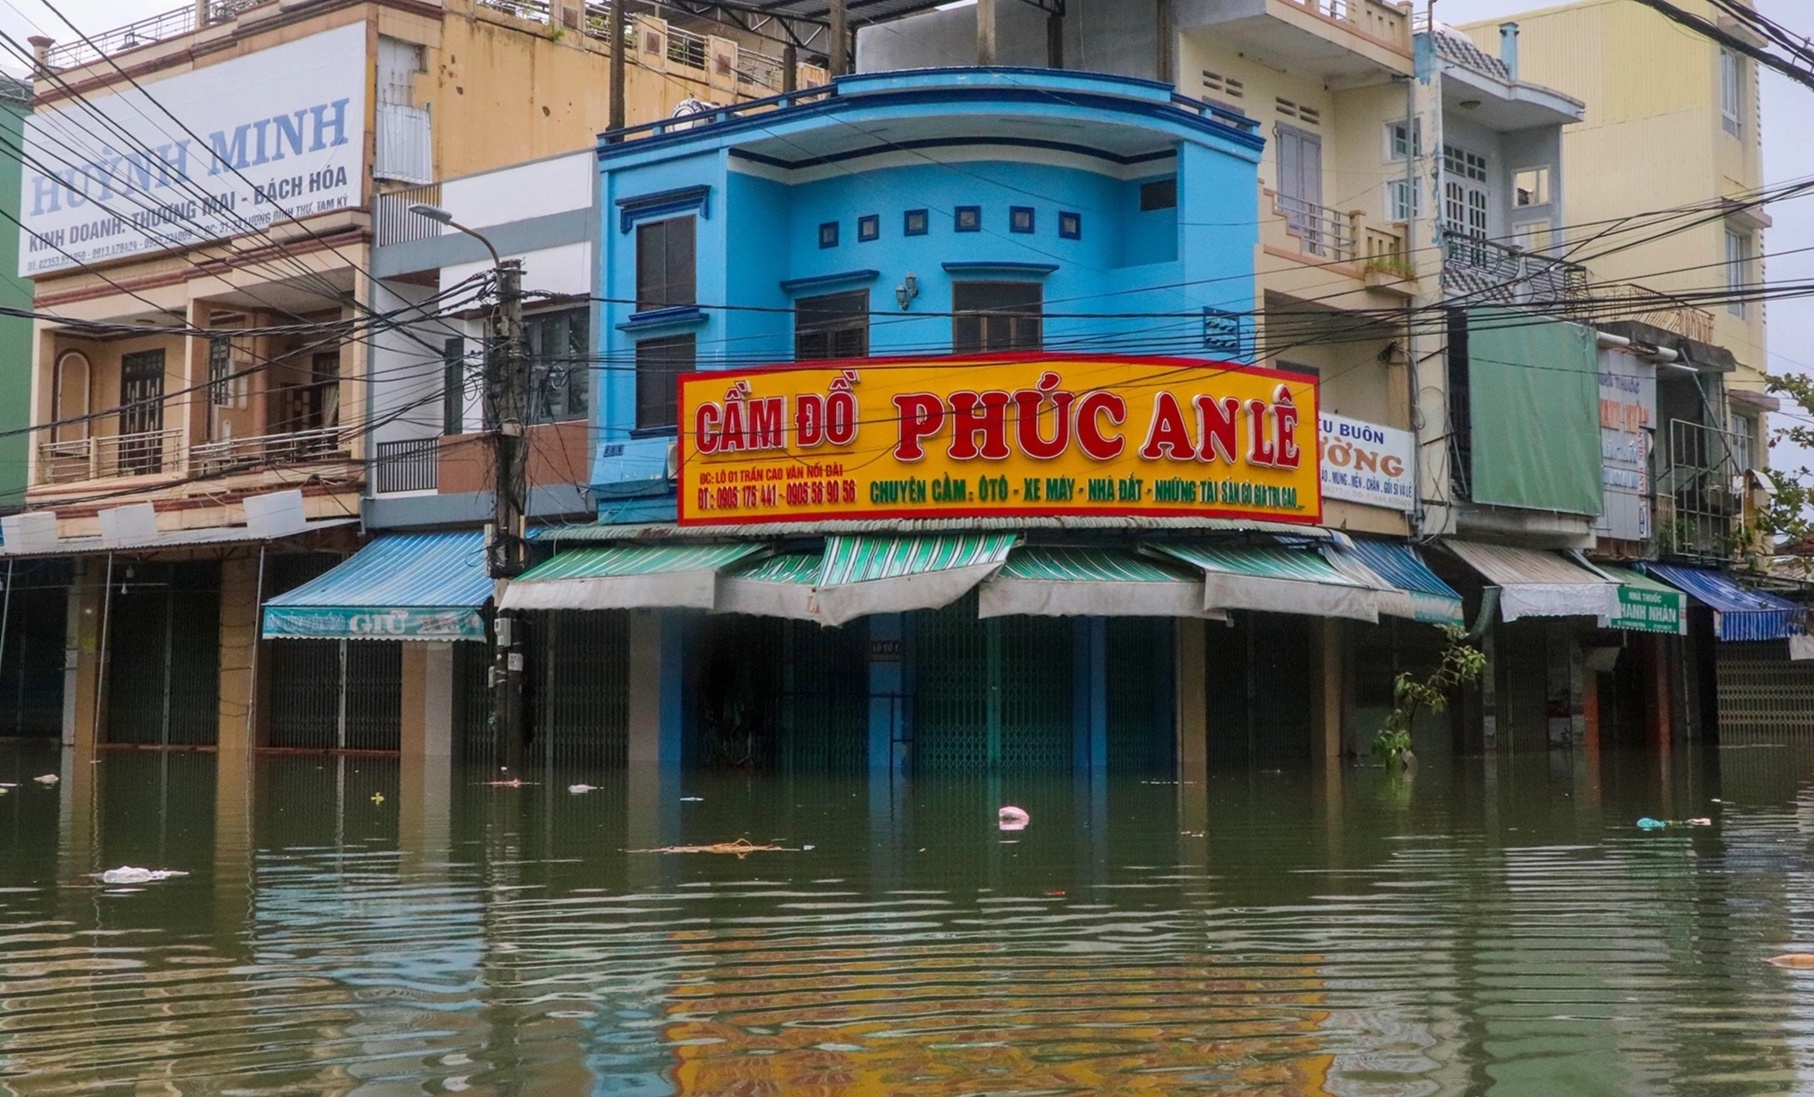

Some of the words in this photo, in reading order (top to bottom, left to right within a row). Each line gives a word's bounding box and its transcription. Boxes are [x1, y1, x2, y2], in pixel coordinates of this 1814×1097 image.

[207, 98, 350, 176] MINH
[29, 229, 65, 253] KINH
[69, 217, 126, 244] DOANH:
[254, 177, 303, 206] BÁCH
[309, 164, 348, 192] HÓA
[317, 197, 335, 212] TAM
[695, 380, 788, 455] CẦM
[794, 369, 861, 448] ĐỒ
[892, 371, 1127, 462] PHÚC
[1339, 425, 1384, 445] BUÔN
[716, 468, 726, 484] LÔ
[765, 470, 784, 481] CAO
[870, 476, 928, 503] CHUYÊN
[978, 474, 1009, 501] ÔTÔ
[1023, 478, 1041, 500] XE
[1045, 474, 1077, 500] MÁY
[1088, 475, 1115, 501] NHÀ
[1118, 472, 1144, 501] ĐẤT
[1154, 476, 1196, 502] NHỮNG
[1199, 477, 1217, 502] TÀI
[716, 485, 740, 509] 0905
[743, 483, 758, 506] 175
[760, 484, 779, 506] 441
[786, 481, 810, 506] 0905
[811, 481, 824, 503] 56
[826, 479, 841, 502] 90
[843, 478, 857, 502] 56
[1621, 603, 1646, 620] HANH
[1648, 604, 1677, 623] NHÀN
